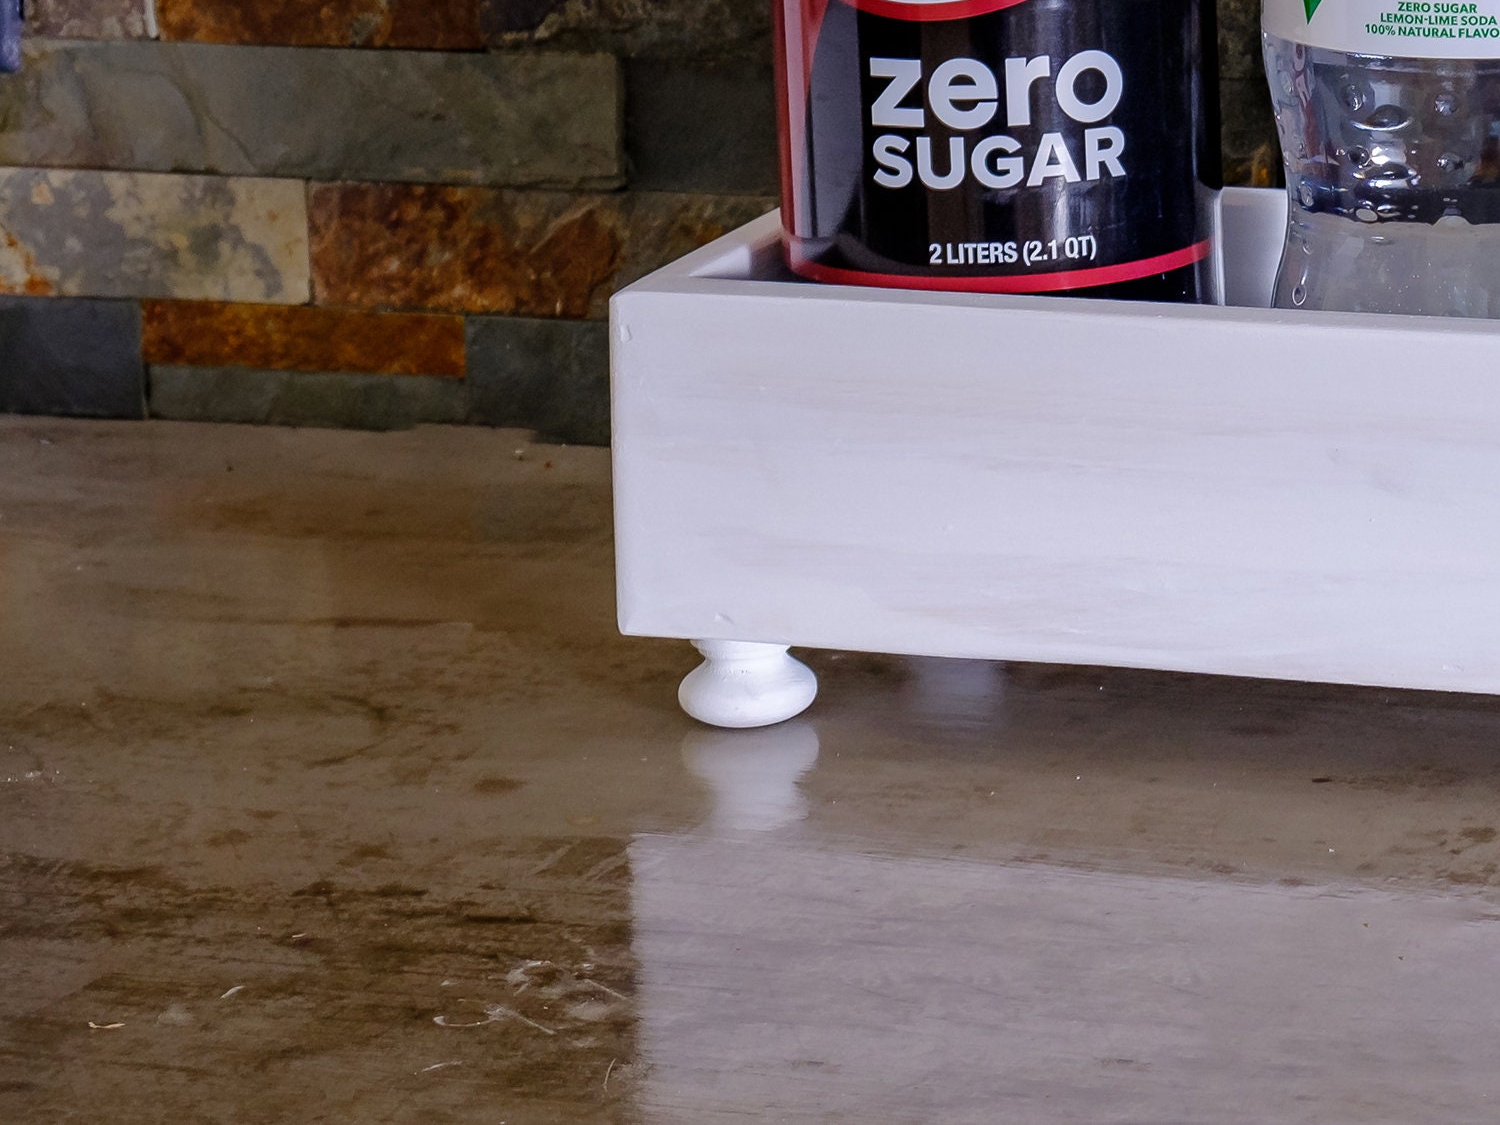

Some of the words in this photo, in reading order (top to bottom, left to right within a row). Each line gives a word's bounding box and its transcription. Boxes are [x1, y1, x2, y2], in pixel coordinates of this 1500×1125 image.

[1380, 12, 1458, 26] LEMON-LIME
[1460, 15, 1498, 26] SODA
[1398, 1, 1431, 13] ZERO
[1434, 2, 1477, 14] SUGAR
[1365, 24, 1396, 36] 100%
[1398, 25, 1457, 39] NATURAL
[868, 49, 1124, 129] zero
[872, 126, 1127, 190] SUGAR
[928, 243, 942, 265] 2
[946, 242, 1019, 265] LITERS
[1023, 240, 1058, 266] (2.1
[1064, 234, 1097, 261] QT)
